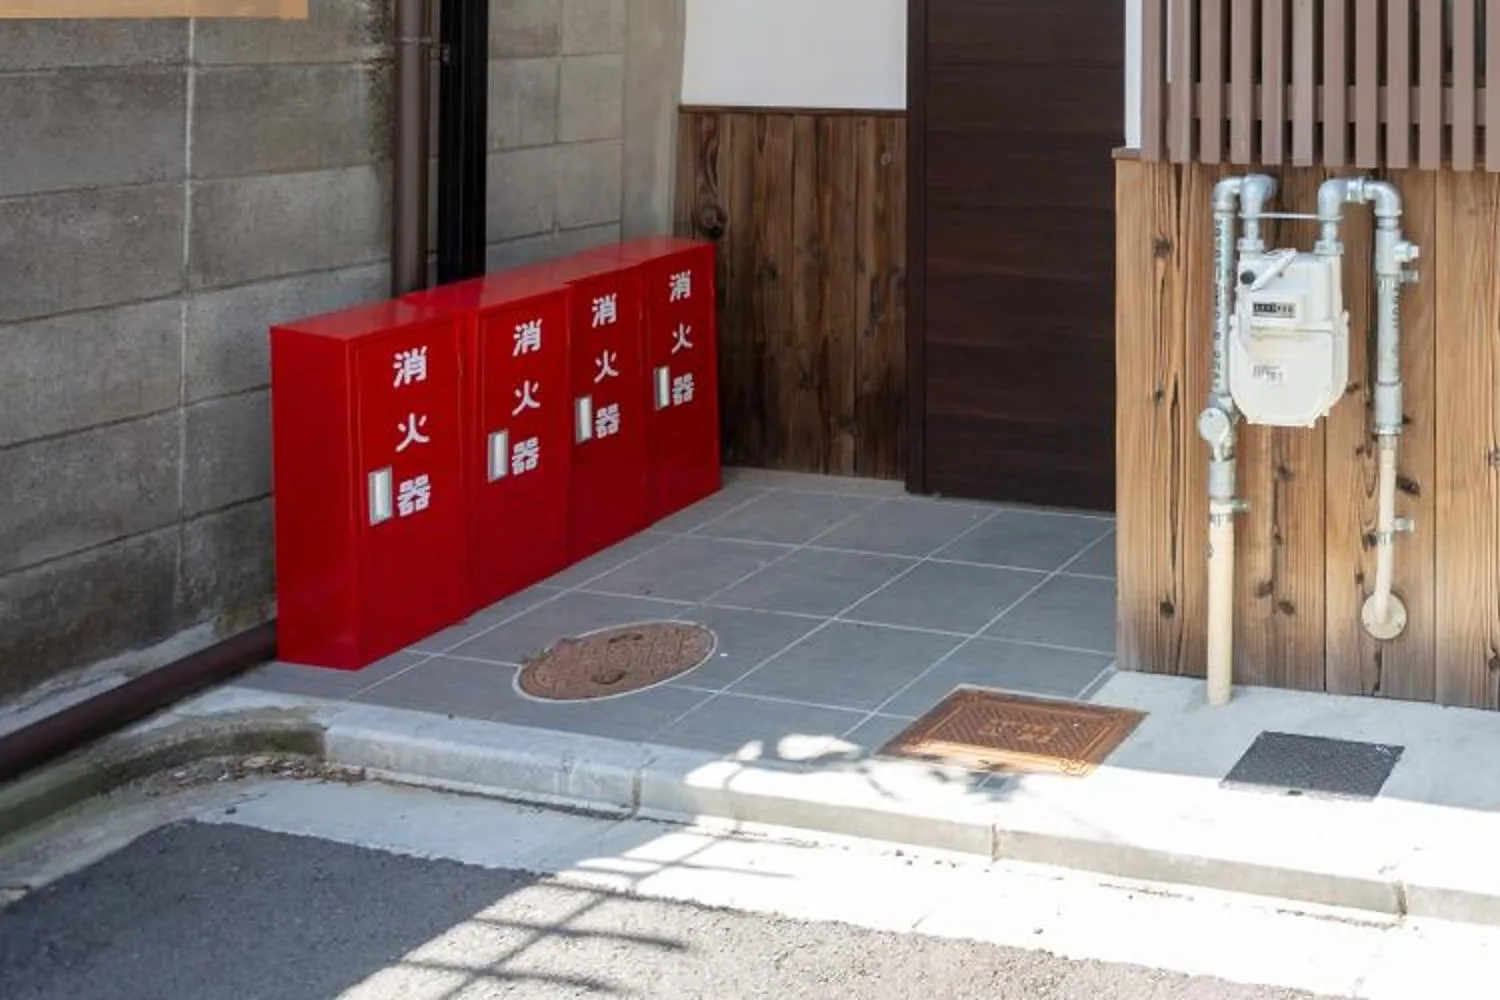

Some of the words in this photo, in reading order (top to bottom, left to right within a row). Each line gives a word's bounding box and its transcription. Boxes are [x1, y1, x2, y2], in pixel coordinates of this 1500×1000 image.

[512, 318, 542, 476] 消火器
[591, 293, 620, 439] 消火器
[669, 270, 695, 405] 消火器
[393, 345, 431, 517] 消火器
